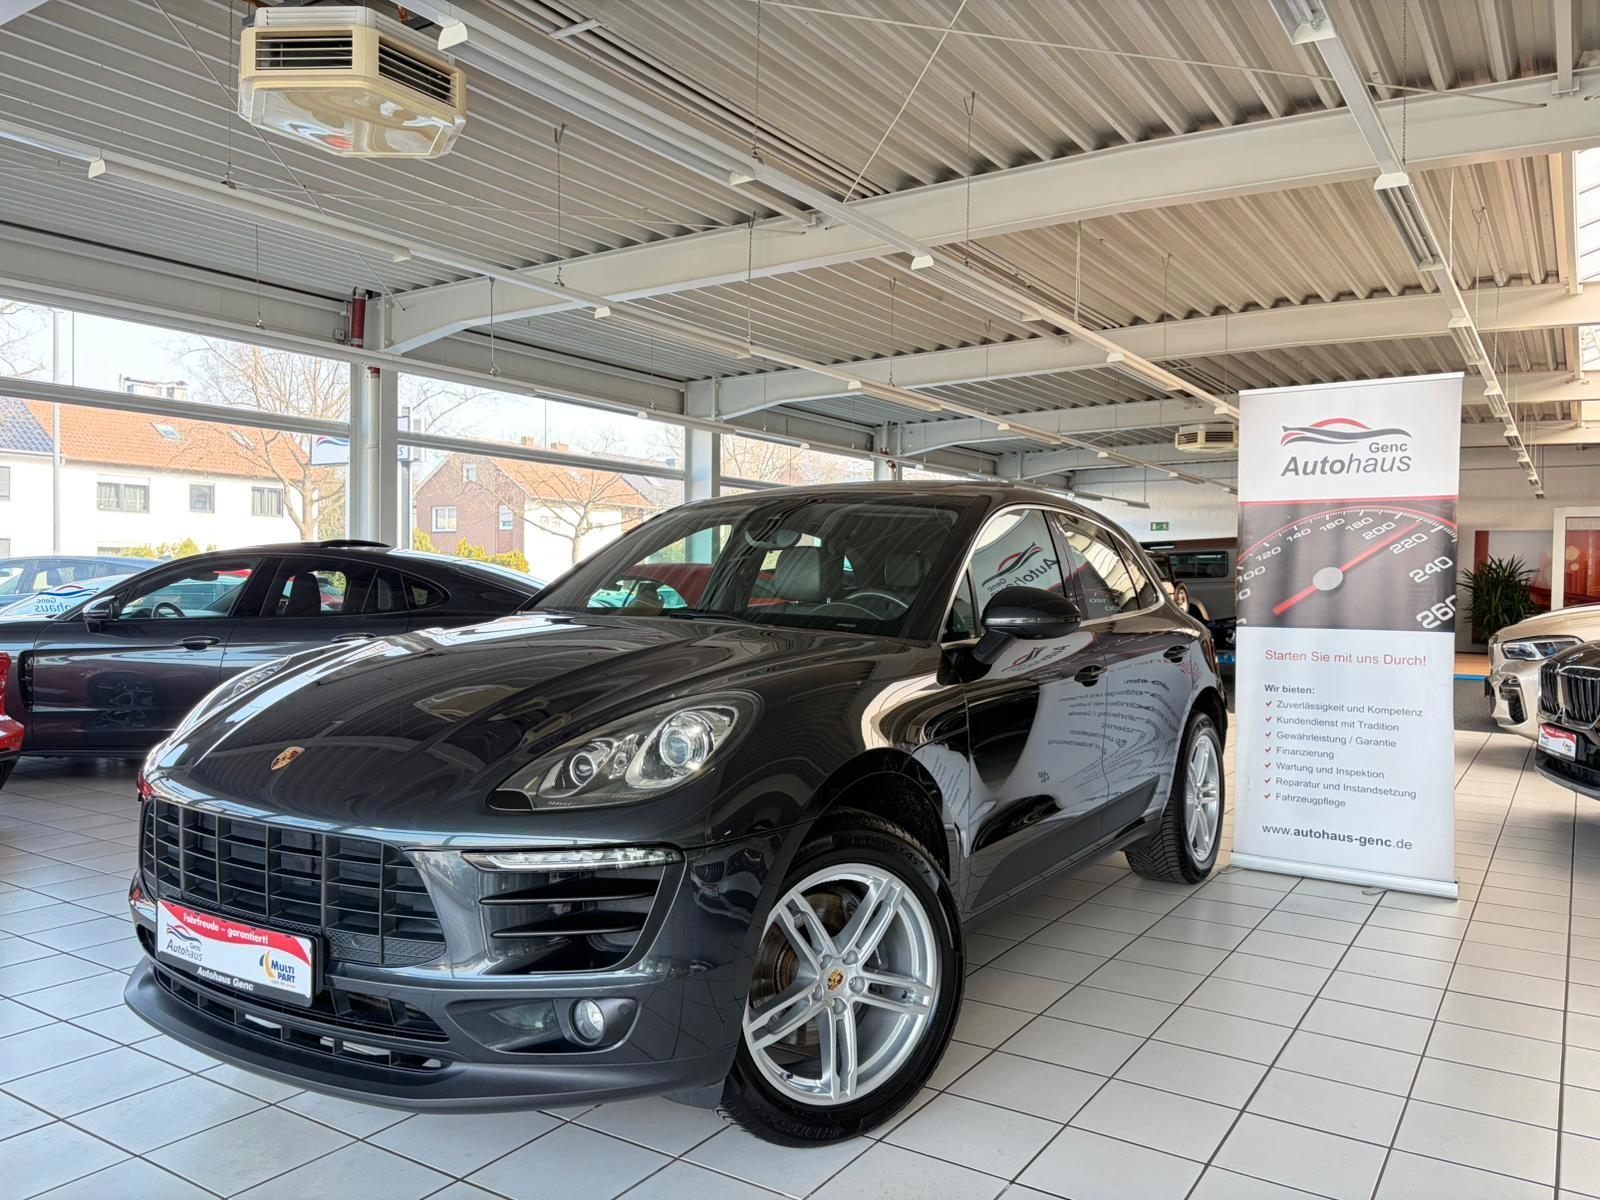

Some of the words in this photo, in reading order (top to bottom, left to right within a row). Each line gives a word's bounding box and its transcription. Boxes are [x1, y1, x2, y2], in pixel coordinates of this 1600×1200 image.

[1369, 442, 1408, 453] Genc
[1281, 454, 1412, 476] Autohaus
[1320, 518, 1345, 532] 160
[1346, 517, 1373, 532] 180
[1362, 521, 1396, 540] 200
[1286, 528, 1311, 542] 140
[1390, 533, 1428, 554] 220
[1256, 547, 1281, 561] 120
[1237, 566, 1266, 583] 100
[1409, 556, 1453, 583] 240
[1265, 650, 1306, 662] Starten
[1311, 652, 1330, 663] Sie
[1334, 652, 1352, 663] mit
[1357, 655, 1379, 664] uns
[1384, 654, 1427, 666] Durch!
[1264, 684, 1280, 692] Wir
[1283, 685, 1315, 694] bieten:
[1276, 700, 1344, 713] Zuverlässigkeit
[1347, 705, 1364, 714] und
[1367, 706, 1423, 718] Kompetenz
[1276, 716, 1338, 728] Kundendienst
[1341, 720, 1355, 728] mit
[1358, 721, 1399, 731] Tradition
[1276, 731, 1346, 745] Gewährleistung
[1355, 736, 1397, 748] Garantie
[1276, 747, 1334, 760] Finanzierung
[1276, 762, 1313, 774] Wartung
[1316, 766, 1333, 775] und
[1336, 767, 1384, 779] Inspektion
[1276, 777, 1320, 789] Reparatur
[1323, 782, 1340, 791] und
[1344, 782, 1416, 800] Instandsetzung
[1276, 793, 1346, 808] Fahrzeugpflege
[1262, 824, 1412, 850] www.autohaus-genc.de
[183, 912, 219, 932] Fahrfreude
[227, 927, 268, 945] garantiert!
[166, 939, 203, 962] Autohaus
[271, 960, 294, 974] MULTI
[197, 967, 231, 985] Autohaus
[233, 978, 254, 991] Genc
[278, 972, 296, 983] PART
